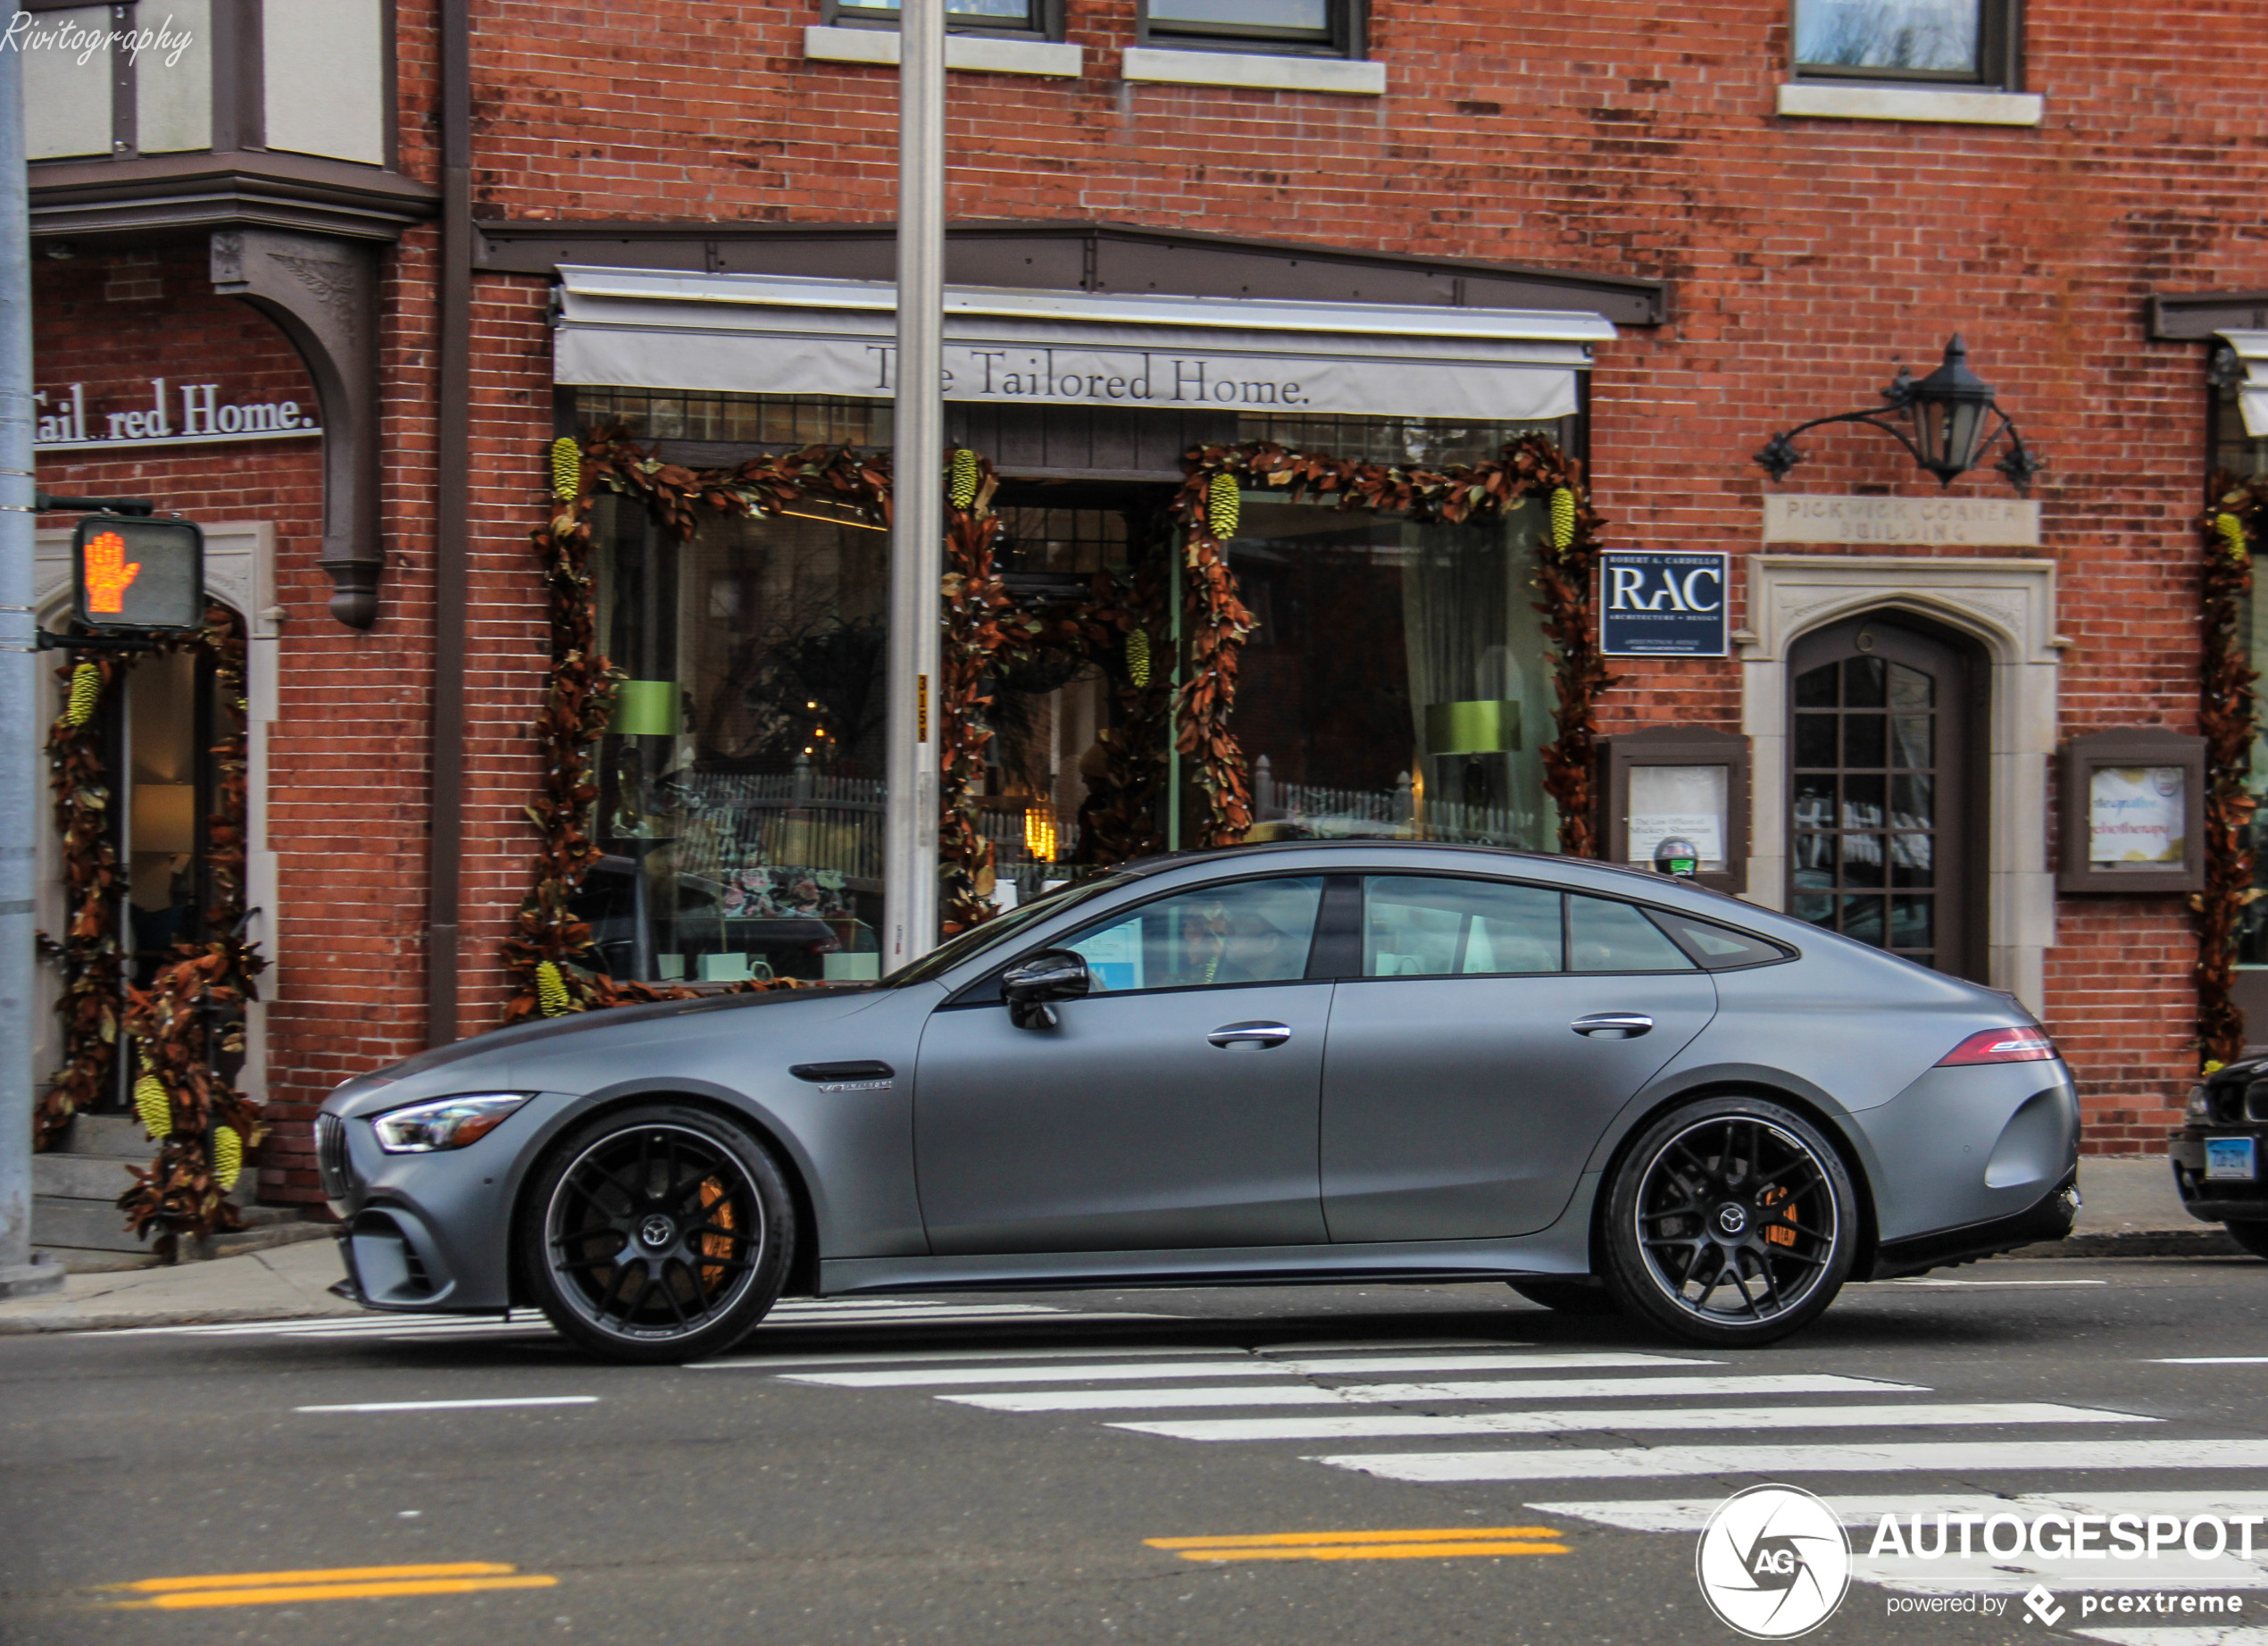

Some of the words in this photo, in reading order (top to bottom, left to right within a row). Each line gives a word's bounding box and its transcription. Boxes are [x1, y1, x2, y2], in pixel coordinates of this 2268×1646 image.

[866, 346, 955, 391] Te
[971, 347, 1153, 401] Tailored
[1170, 360, 1310, 405] Home.
[180, 384, 314, 435] Home.
[1788, 501, 1907, 520] PICKWICK
[1920, 502, 2019, 522] CORNER
[1840, 522, 1965, 541] BUILDING
[1609, 556, 1649, 564] ROBERT
[1664, 556, 1719, 564] CARDELLO
[1608, 567, 1722, 612] RAC
[1855, 622, 1873, 652] 6
